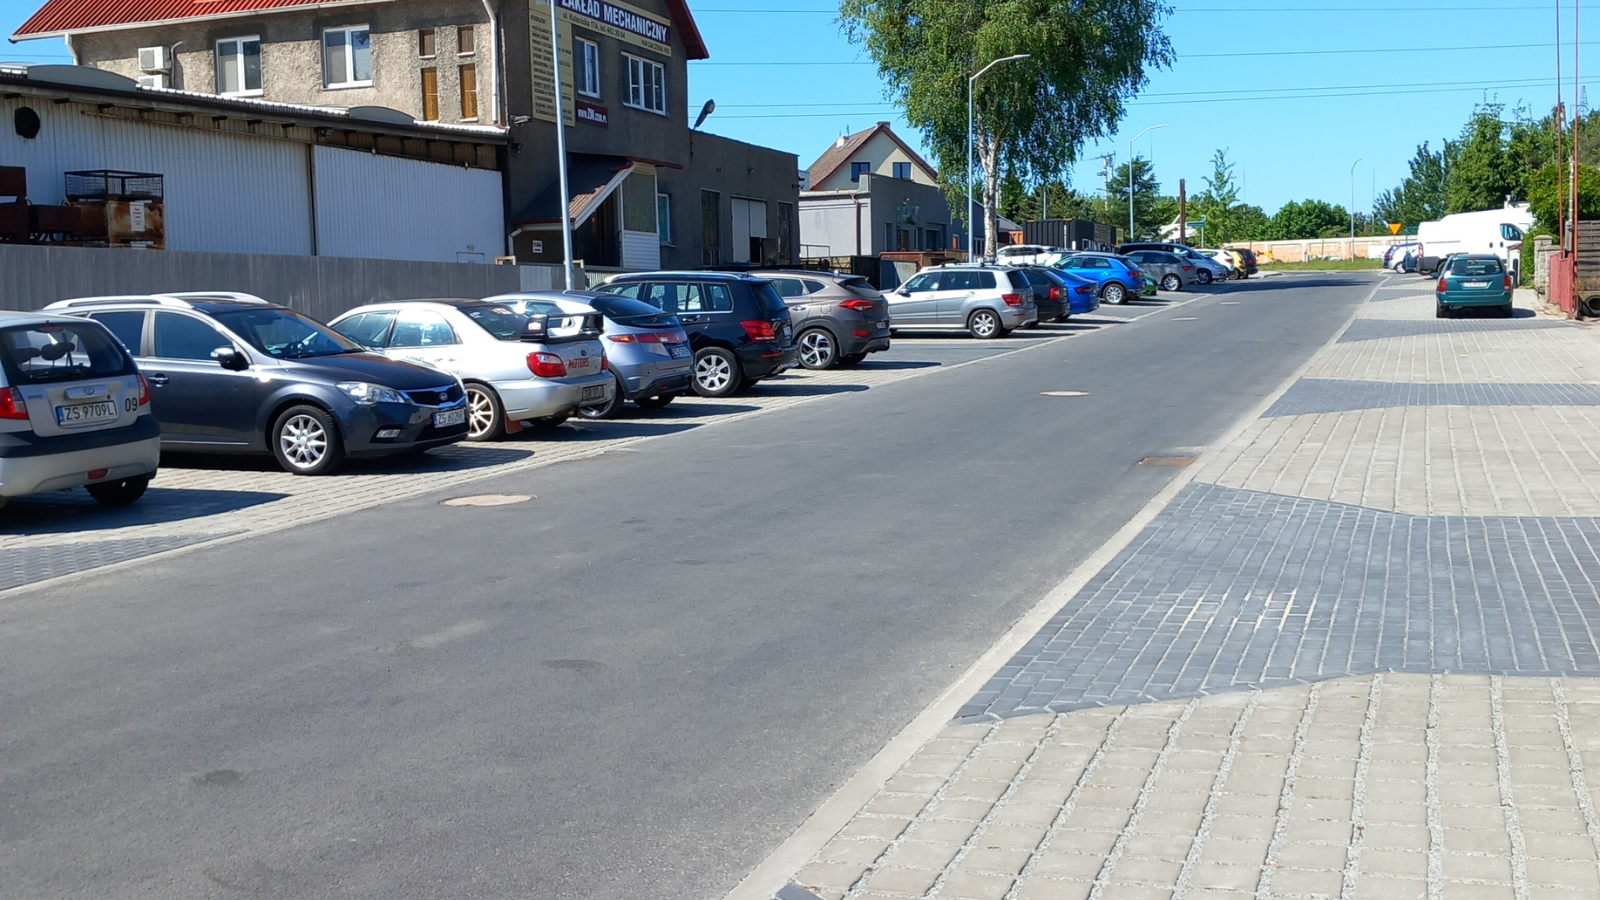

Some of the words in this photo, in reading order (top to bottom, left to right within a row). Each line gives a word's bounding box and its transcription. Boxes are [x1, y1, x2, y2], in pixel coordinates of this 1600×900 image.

[603, 4, 667, 42] MECHANICZNY
[568, 357, 590, 369] MOTORS
[64, 406, 81, 420] ZS
[82, 404, 114, 418] 9709L
[125, 397, 138, 412] 09
[437, 413, 447, 426] ZS
